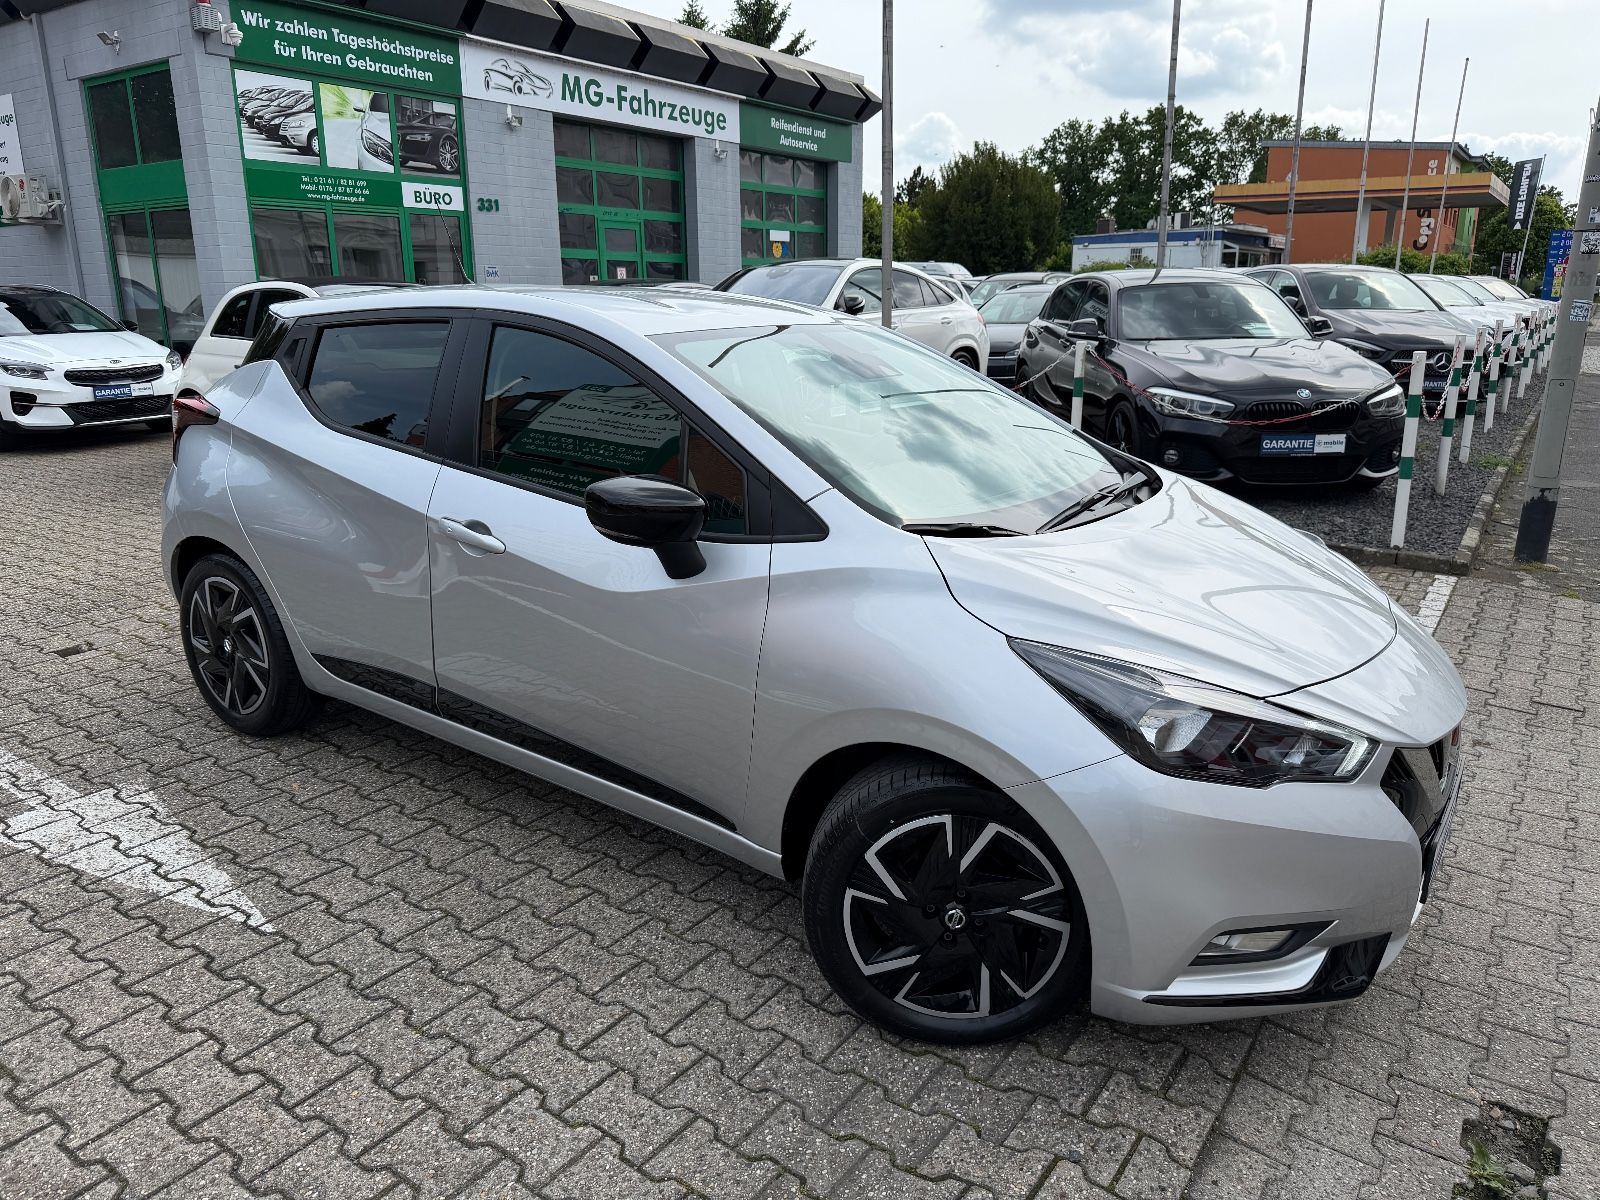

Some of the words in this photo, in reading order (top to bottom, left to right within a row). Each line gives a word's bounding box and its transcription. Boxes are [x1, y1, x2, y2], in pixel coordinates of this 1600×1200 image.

[240, 9, 271, 29] Wir
[275, 19, 328, 40] zahlen
[331, 27, 454, 65] Tageshöchstpreise
[273, 39, 297, 58] für
[301, 45, 342, 65] Ihren
[346, 53, 433, 82] Gebrauchten
[561, 73, 727, 135] MG-Fahrzeuge
[770, 117, 812, 137] Reifendienst
[813, 128, 826, 139] und
[779, 134, 818, 152] Autoservice
[300, 183, 318, 191] Mobil:
[318, 184, 333, 192] 0176
[301, 175, 313, 183] Tel.:
[413, 187, 453, 206] BÜRO
[477, 197, 500, 212] 331
[95, 387, 131, 397] GARANTIE
[1262, 439, 1314, 449] GARANTIE
